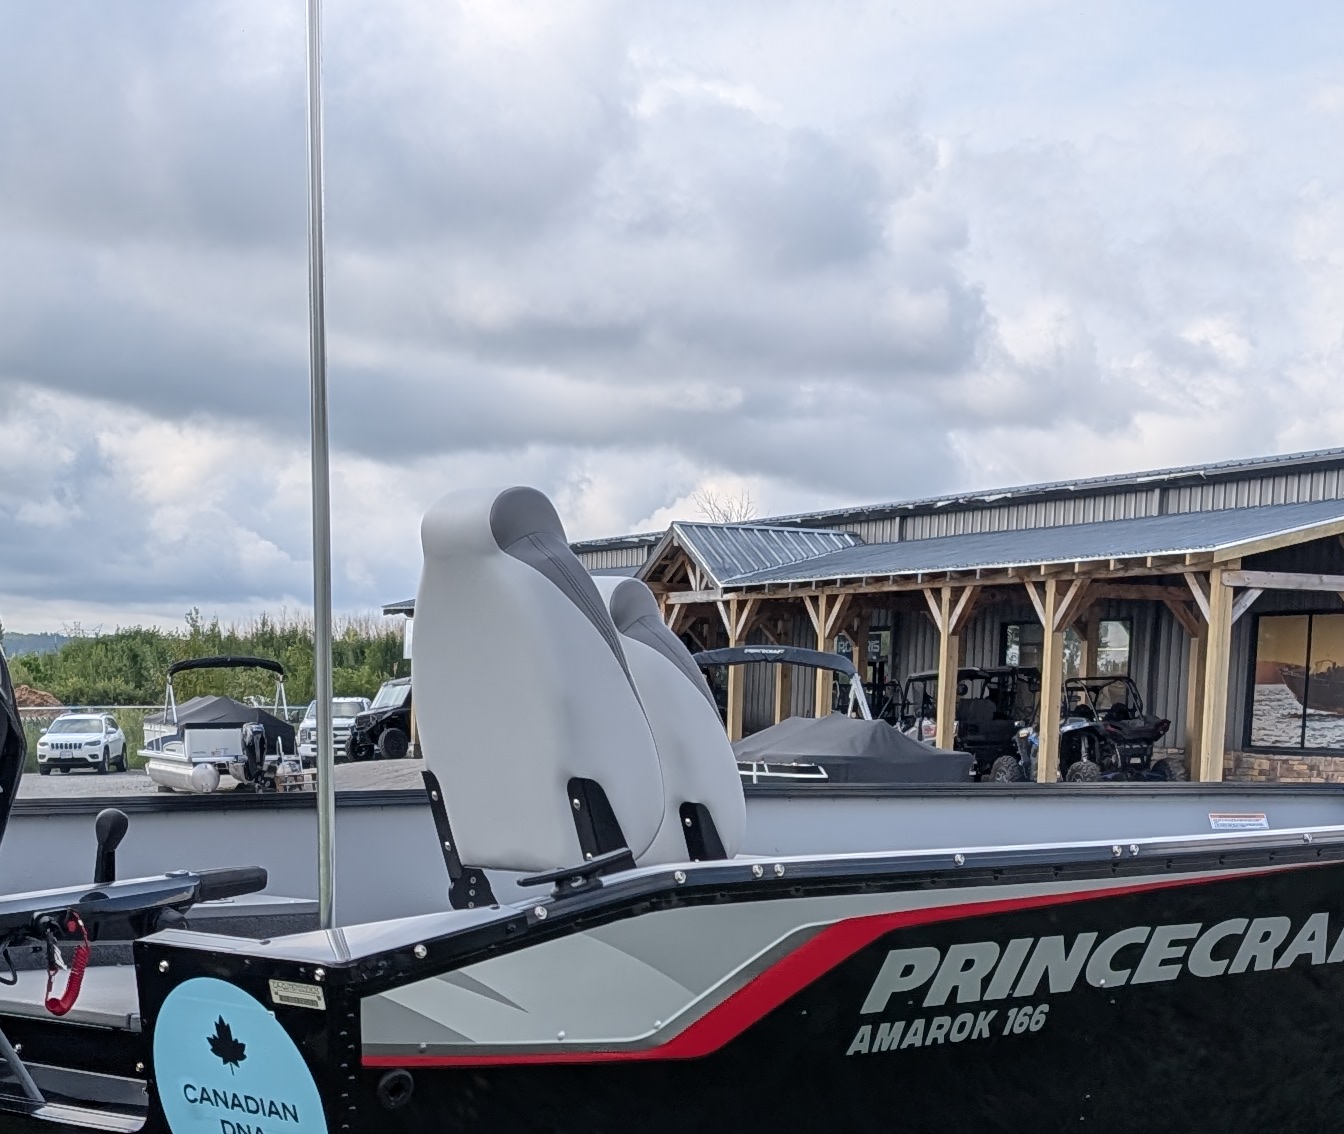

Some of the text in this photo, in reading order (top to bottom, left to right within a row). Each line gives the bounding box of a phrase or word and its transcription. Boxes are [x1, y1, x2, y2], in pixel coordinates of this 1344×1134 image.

[846, 1004, 1049, 1055] AMAROK 166
[183, 1084, 299, 1123] CANADIAN
